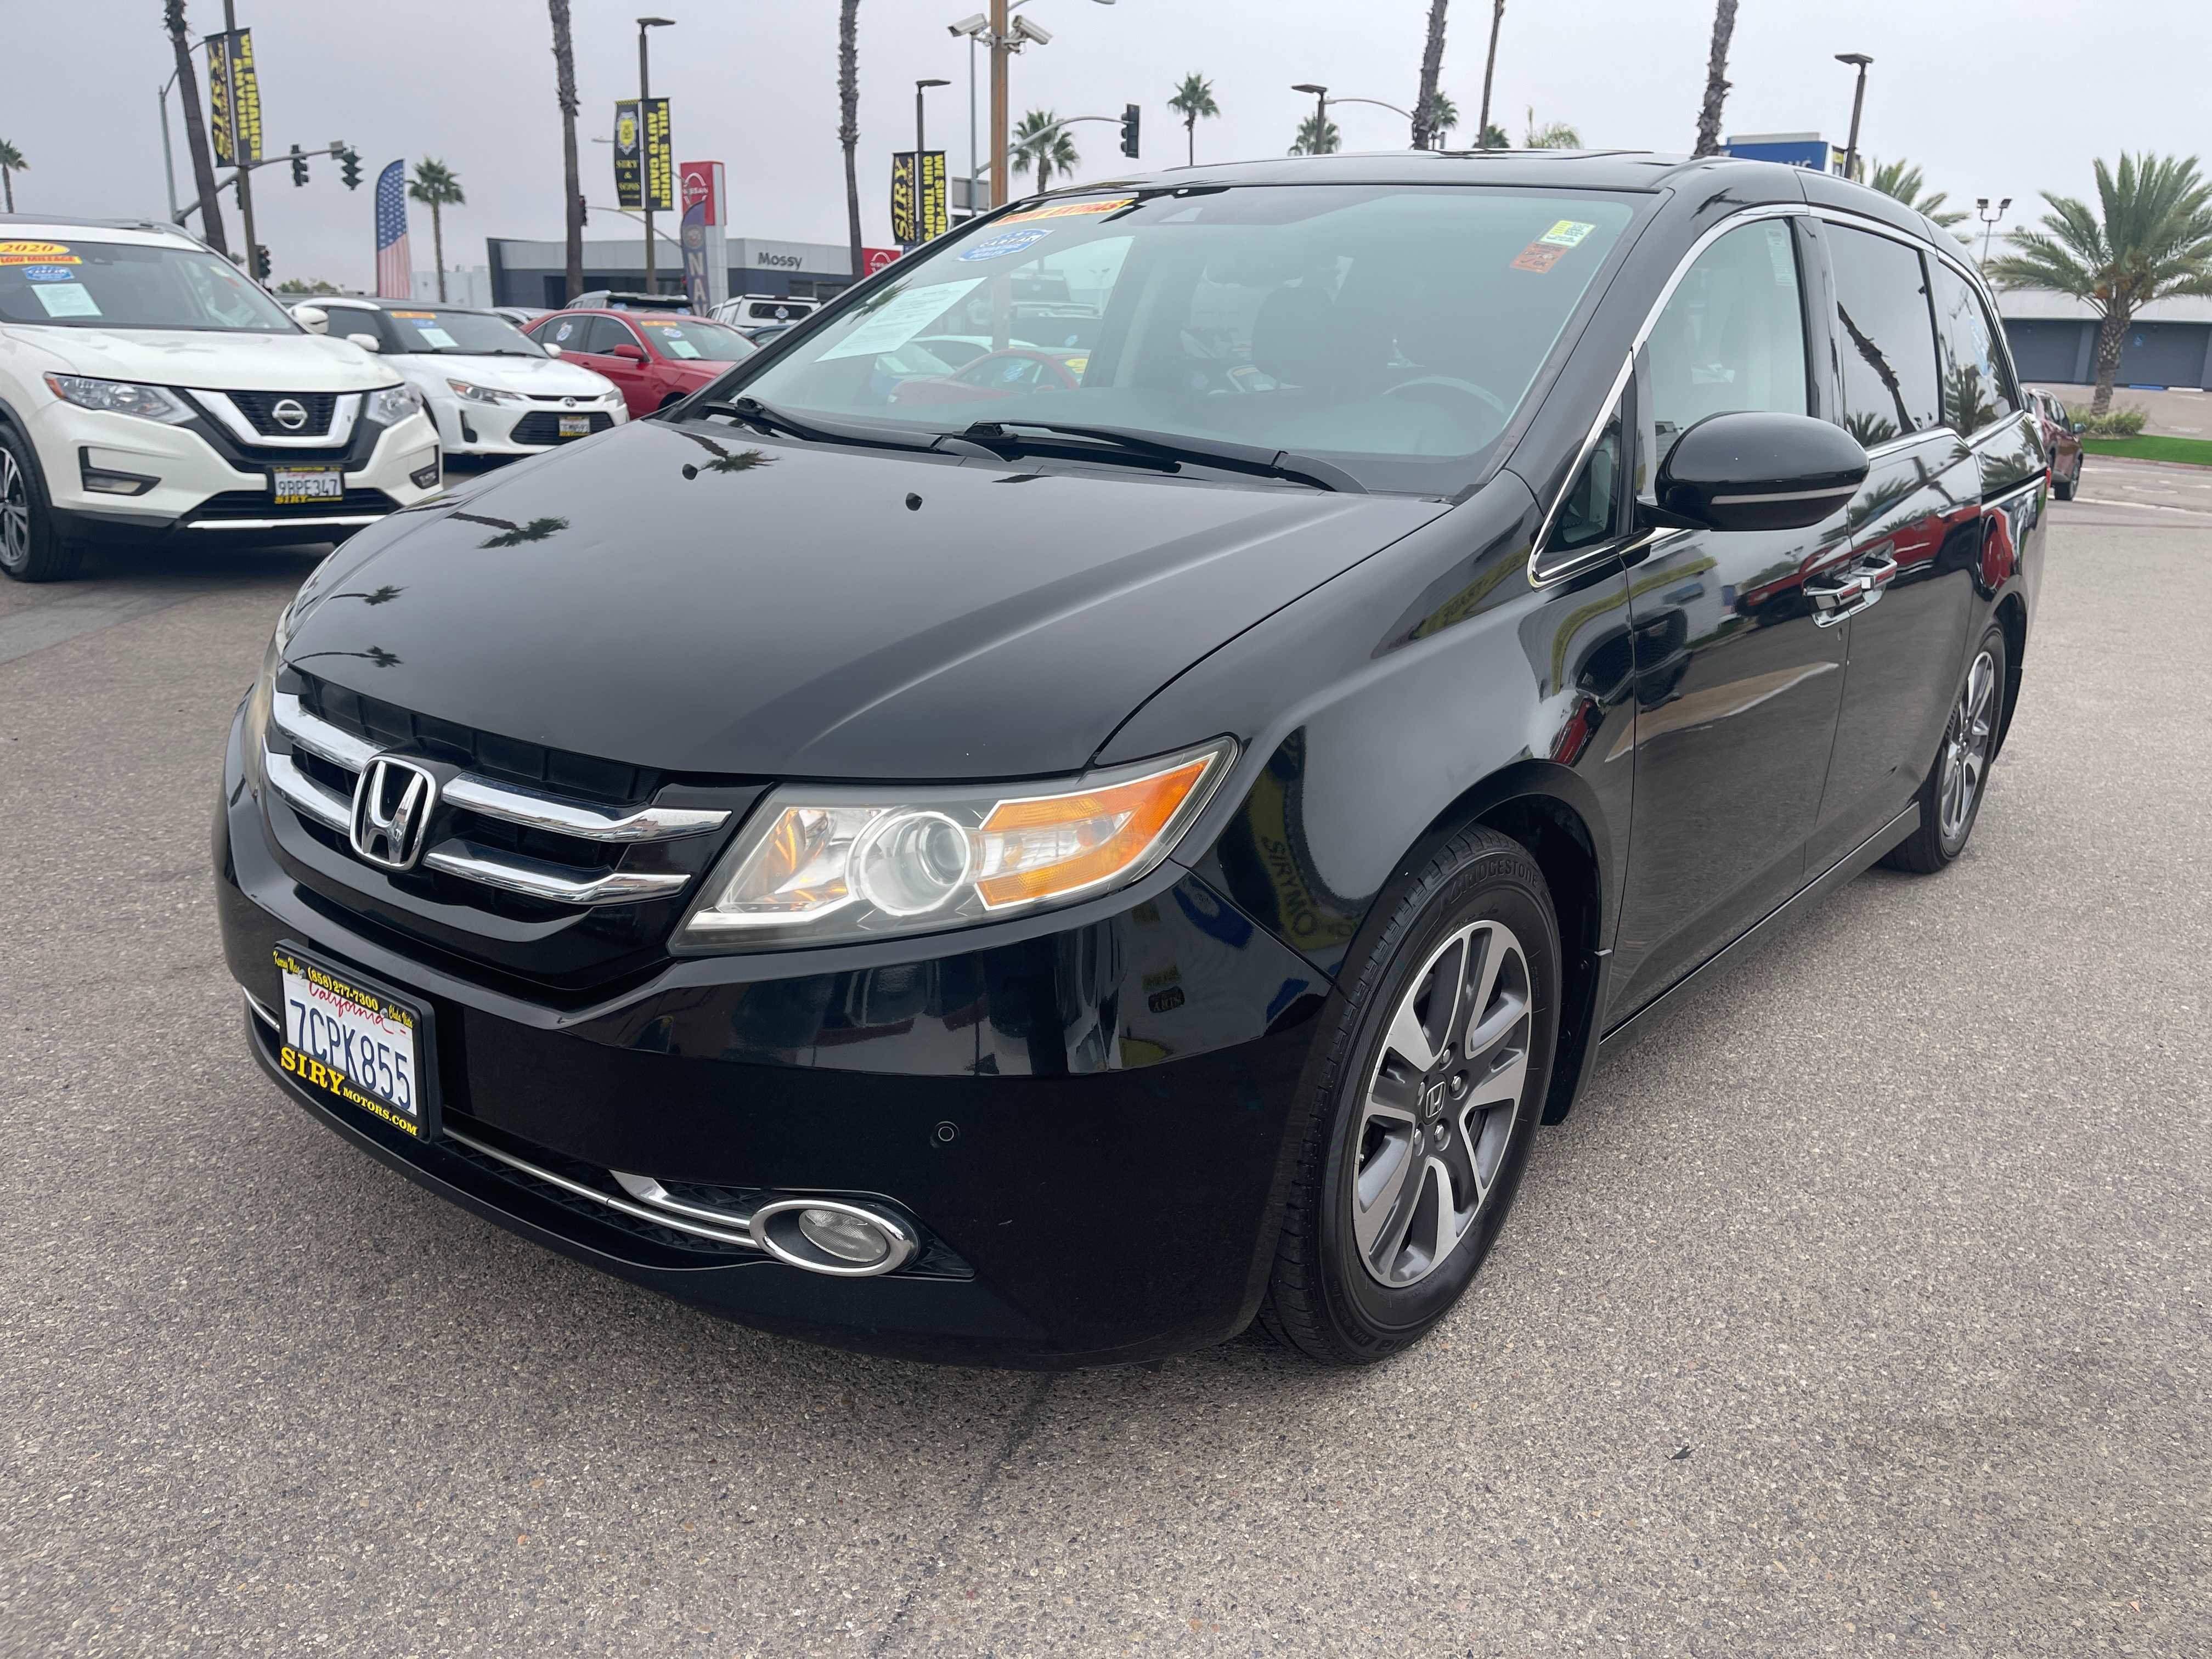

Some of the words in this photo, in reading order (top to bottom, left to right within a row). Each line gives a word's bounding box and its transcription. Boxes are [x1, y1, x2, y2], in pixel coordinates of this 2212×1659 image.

[240, 34, 253, 68] WE
[233, 57, 249, 140] ANYONE
[245, 72, 261, 161] FINANCE
[658, 101, 669, 136] FULL
[647, 112, 659, 155] AUTO
[649, 157, 661, 198] CARE
[659, 143, 671, 208] SERVICE
[923, 155, 933, 185] OUR
[934, 154, 944, 177] WE
[894, 156, 910, 241] SIRY
[923, 187, 935, 241] TROOPS
[934, 179, 946, 235] SUPPOR
[758, 252, 803, 270] Mossy
[1450, 859, 1538, 905] BRIDGESTONE
[308, 967, 332, 991] (858)
[333, 981, 379, 1011] 277-7300
[309, 981, 394, 1035] California
[290, 998, 411, 1110] 7CPK855
[281, 1046, 345, 1095] SIRY
[342, 1087, 417, 1136] MOTORS.COM
